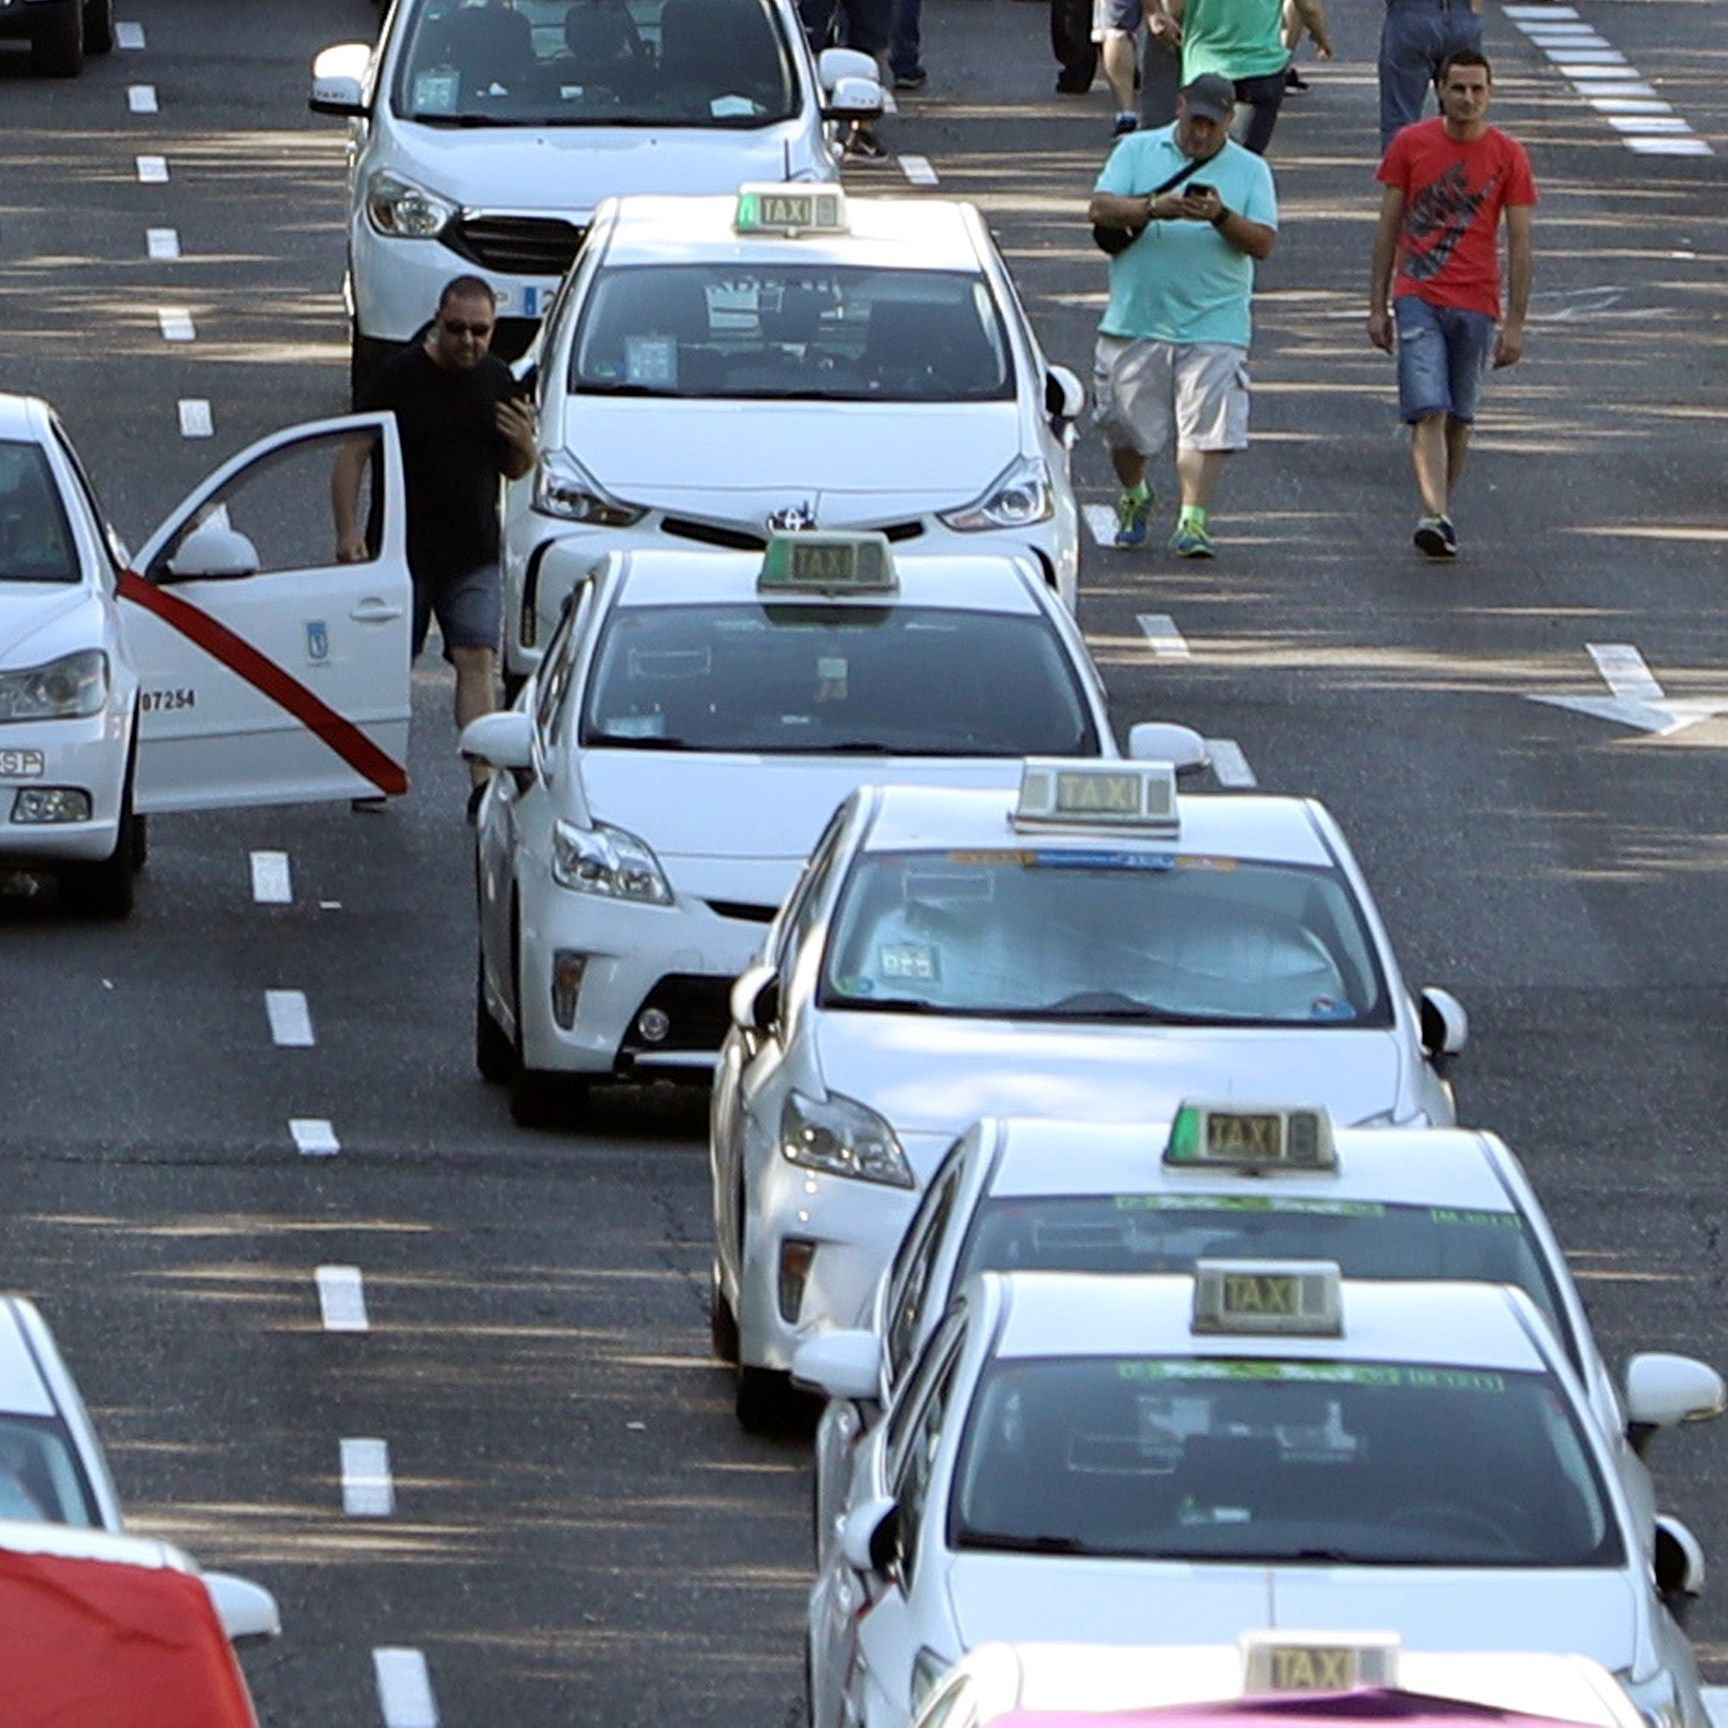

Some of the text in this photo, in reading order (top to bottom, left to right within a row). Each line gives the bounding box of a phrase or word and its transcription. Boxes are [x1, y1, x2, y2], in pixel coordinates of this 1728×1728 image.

[765, 199, 809, 222] TAXI
[795, 545, 851, 578] TAXI
[1, 752, 40, 774] SP
[1066, 774, 1141, 811] TAXI
[1211, 1116, 1277, 1153] TAXI
